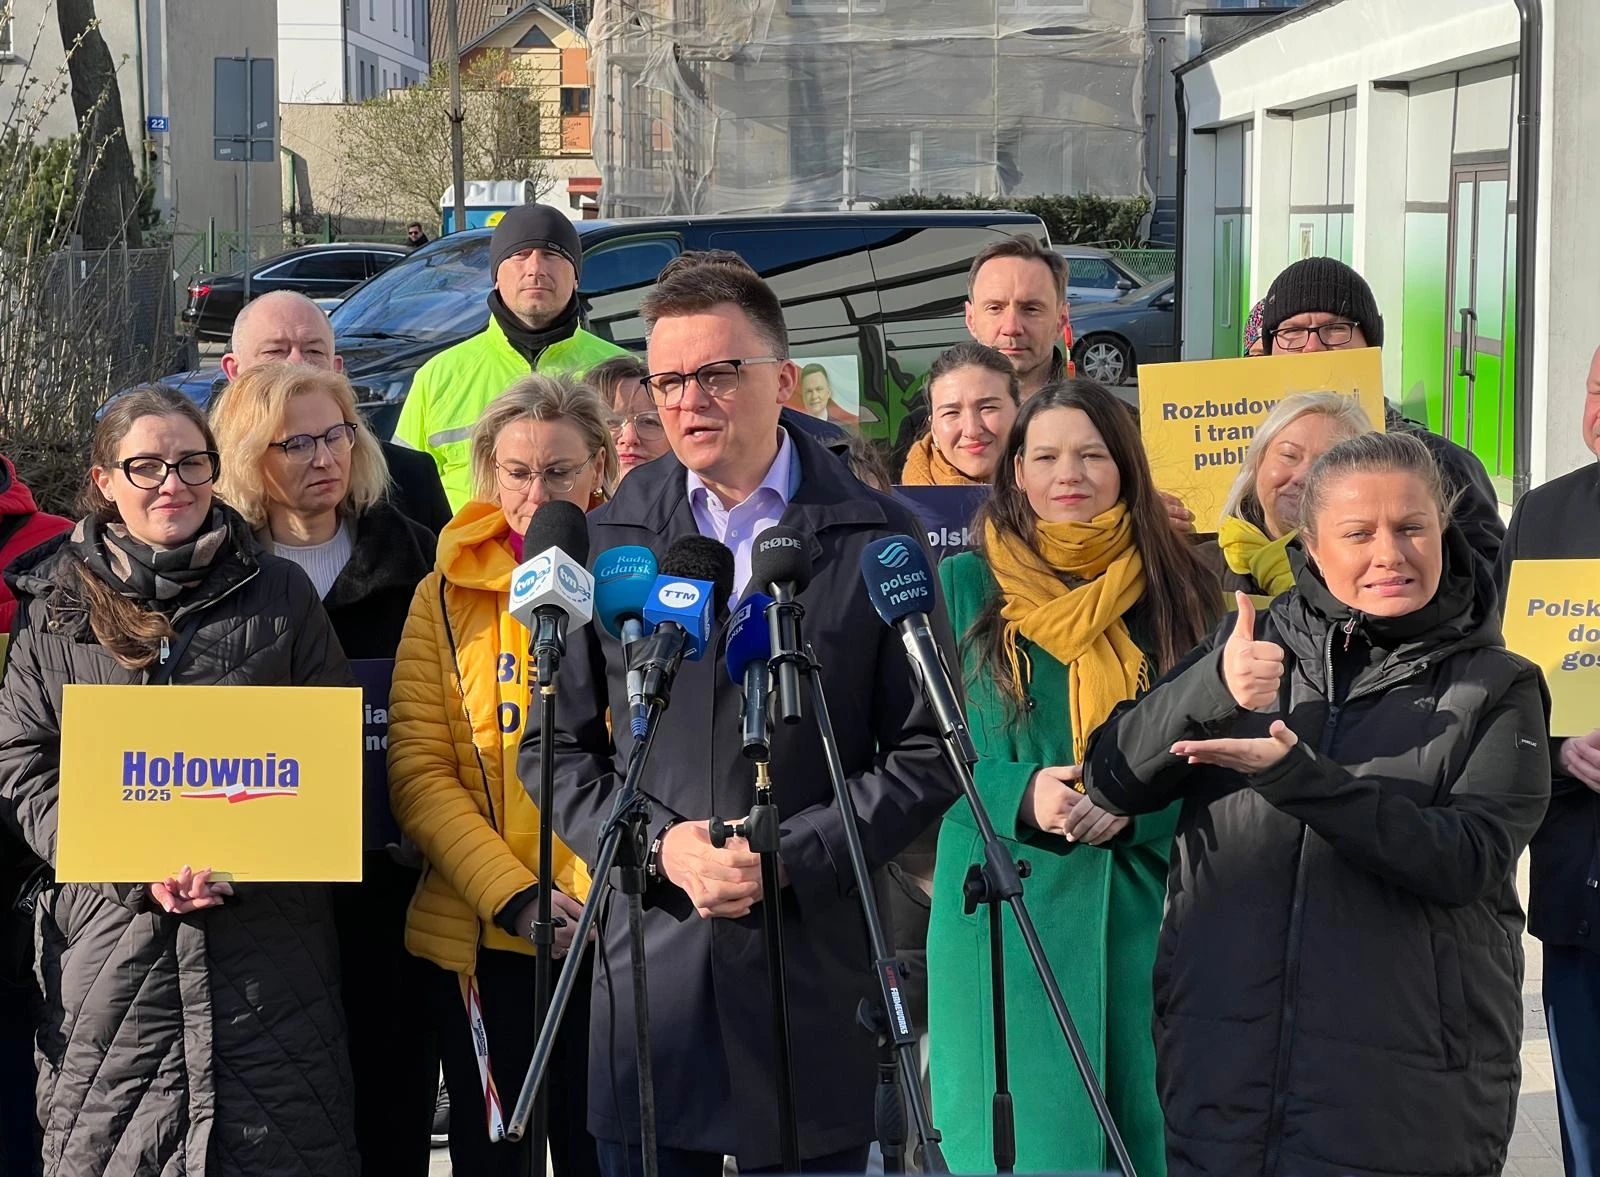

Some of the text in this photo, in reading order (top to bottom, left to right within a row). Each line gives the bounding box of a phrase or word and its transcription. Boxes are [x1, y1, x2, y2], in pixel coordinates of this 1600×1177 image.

[151, 119, 165, 128] 22
[1162, 398, 1281, 420] Rozbudow
[1194, 425, 1254, 442] i tran
[1195, 447, 1249, 470] publi
[927, 527, 971, 547] olsk
[601, 563, 651, 577] Gdańsk
[617, 556, 652, 565] Radio
[880, 570, 928, 596] polsat
[664, 589, 696, 601] TTM
[890, 586, 928, 606] news
[364, 704, 388, 724] ia
[122, 751, 299, 787] Hołownia
[122, 788, 171, 801] 2025
